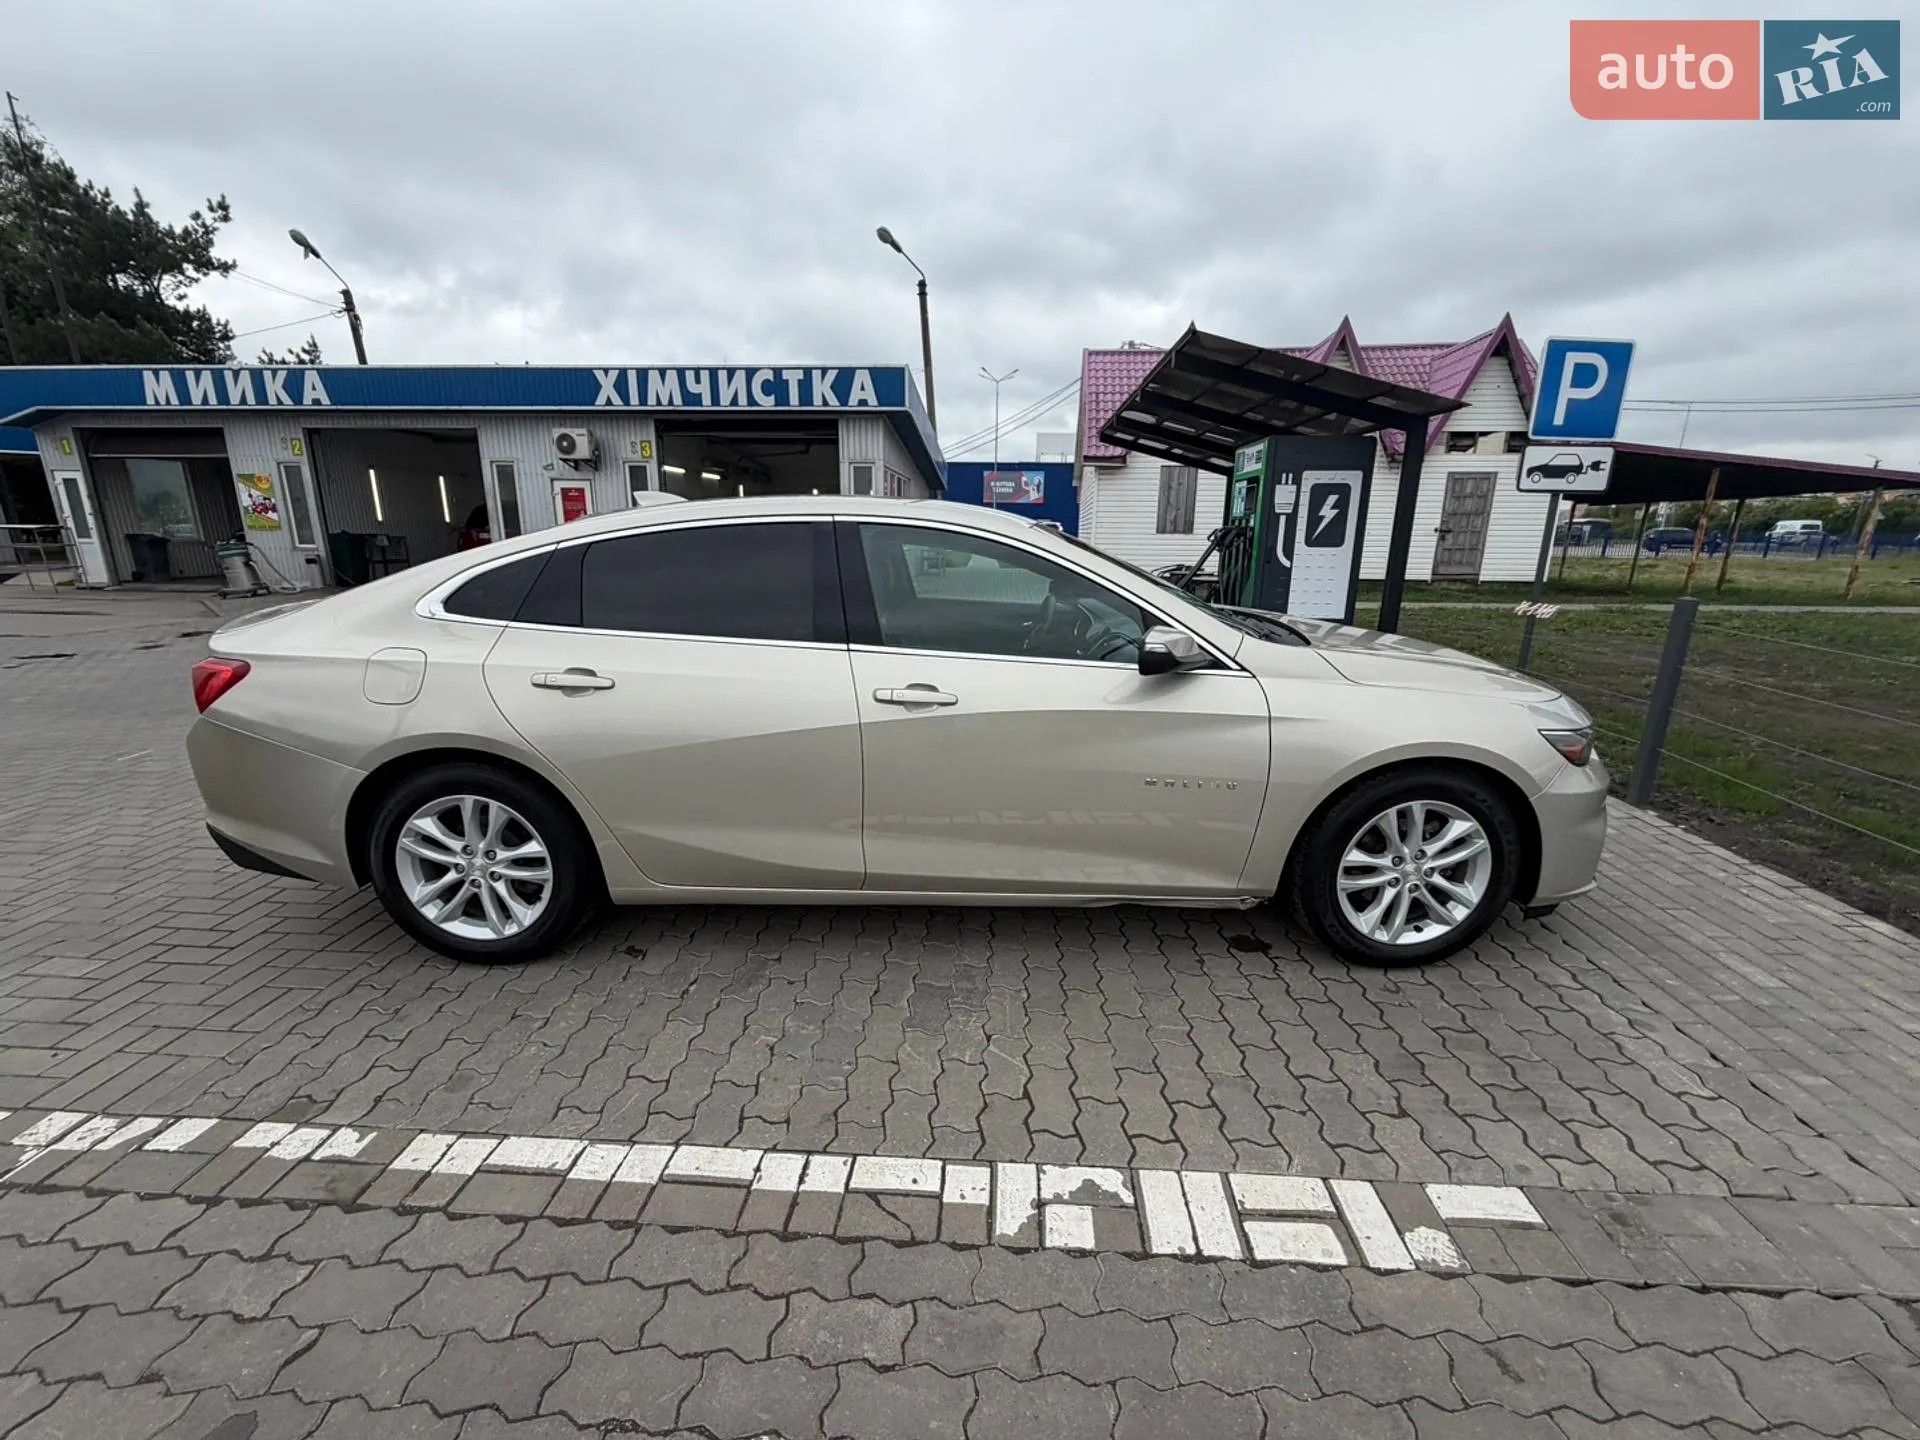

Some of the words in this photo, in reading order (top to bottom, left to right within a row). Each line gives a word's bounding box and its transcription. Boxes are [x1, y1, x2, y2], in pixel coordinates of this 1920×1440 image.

[592, 368, 879, 407] ХІМЧИСТКА
[1552, 351, 1608, 426] P
[292, 439, 302, 456] 2
[642, 441, 651, 458] 3
